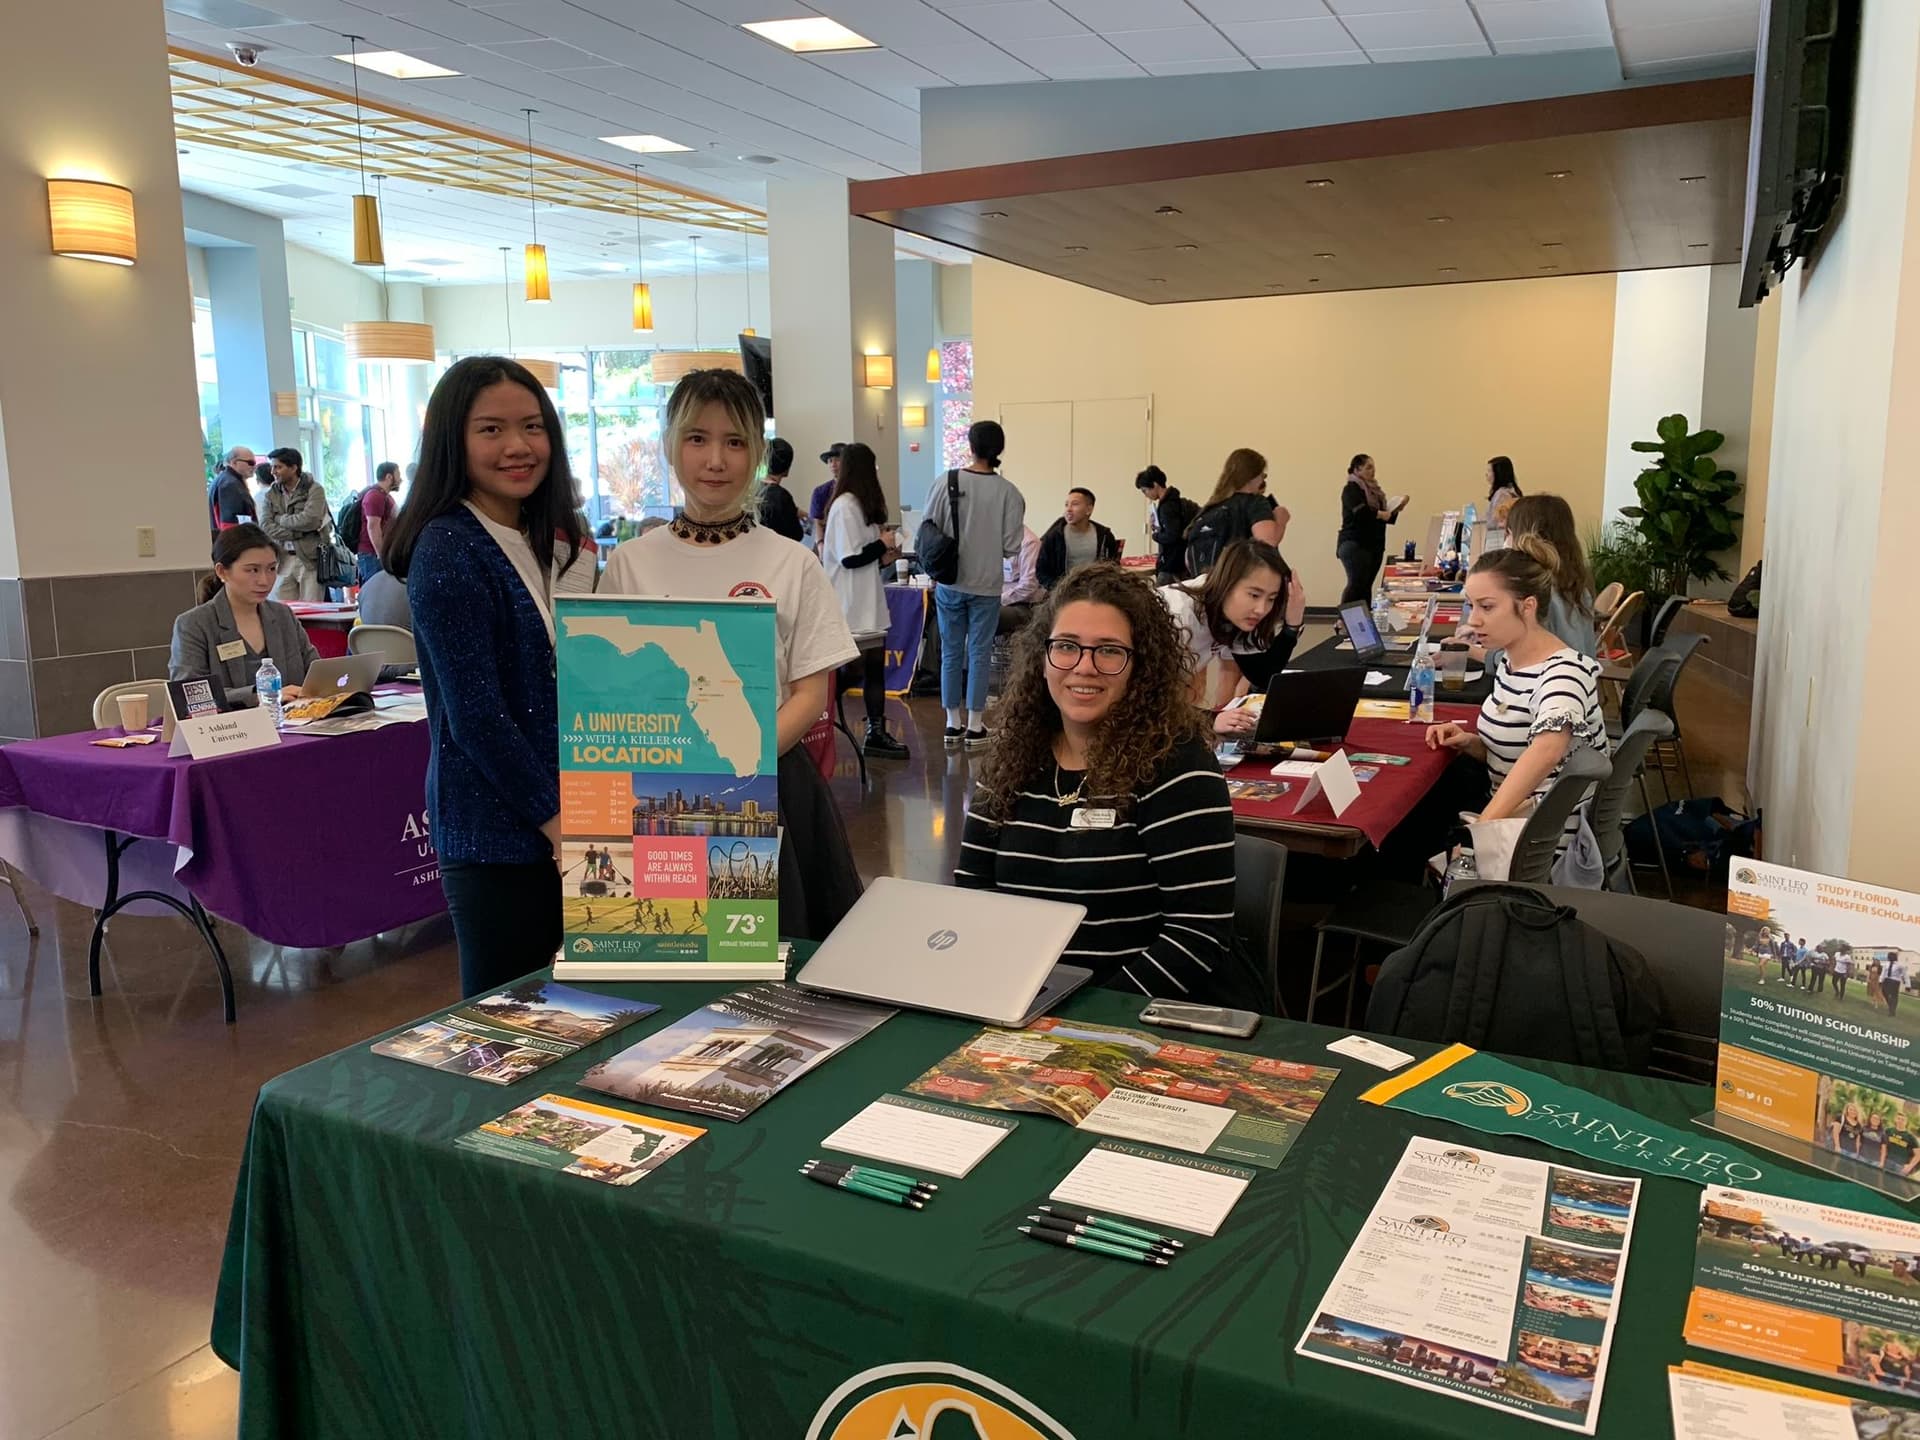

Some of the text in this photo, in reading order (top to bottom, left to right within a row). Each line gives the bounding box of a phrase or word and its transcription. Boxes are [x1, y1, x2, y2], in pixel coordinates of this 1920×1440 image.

[198, 721, 238, 735] 2 Ashland
[574, 712, 681, 733] A UNIVERSITY
[211, 731, 248, 744] University
[585, 735, 670, 745] WITH A KILLER
[573, 746, 683, 764] LOCATION
[647, 850, 694, 861] GOOD TIMES
[647, 862, 694, 872] ARE ALWAYS
[412, 869, 441, 886] ASHL
[643, 873, 697, 884] WITHIN REACH
[1757, 872, 1900, 907] SAINT LEO STUDY FLORIDA
[1816, 895, 1920, 926] TRANSFER SCHOLAR
[593, 940, 620, 949] SAINT
[622, 940, 641, 949] LEO
[1750, 997, 1911, 1049] 50% TUITION SCHOLARSHIP
[1750, 1034, 1786, 1051] Automatically
[1111, 1093, 1135, 1103] SAINT
[1144, 1100, 1189, 1113] UNIVERSITY
[1113, 1089, 1148, 1099] WELCOME
[940, 1107, 1013, 1129] UNIVERSITY
[1524, 1112, 1744, 1187] UNIVERSITY
[1532, 1103, 1763, 1181] SAINT LEO
[1099, 1141, 1250, 1179] SAINT LEO UNIVERSITY
[1414, 1150, 1458, 1170] SAINT
[1819, 1208, 1860, 1222] STUDY
[1862, 1216, 1920, 1232] FLORIDA
[1820, 1216, 1920, 1238] TRANSFER SCHO
[1375, 1215, 1467, 1248] SAINT LEO
[1741, 1262, 1920, 1307] 50% TUITION SCHOLAR
[1357, 1355, 1536, 1410] WWW.SAINTLEO.EDU/INTERNATIONAL
